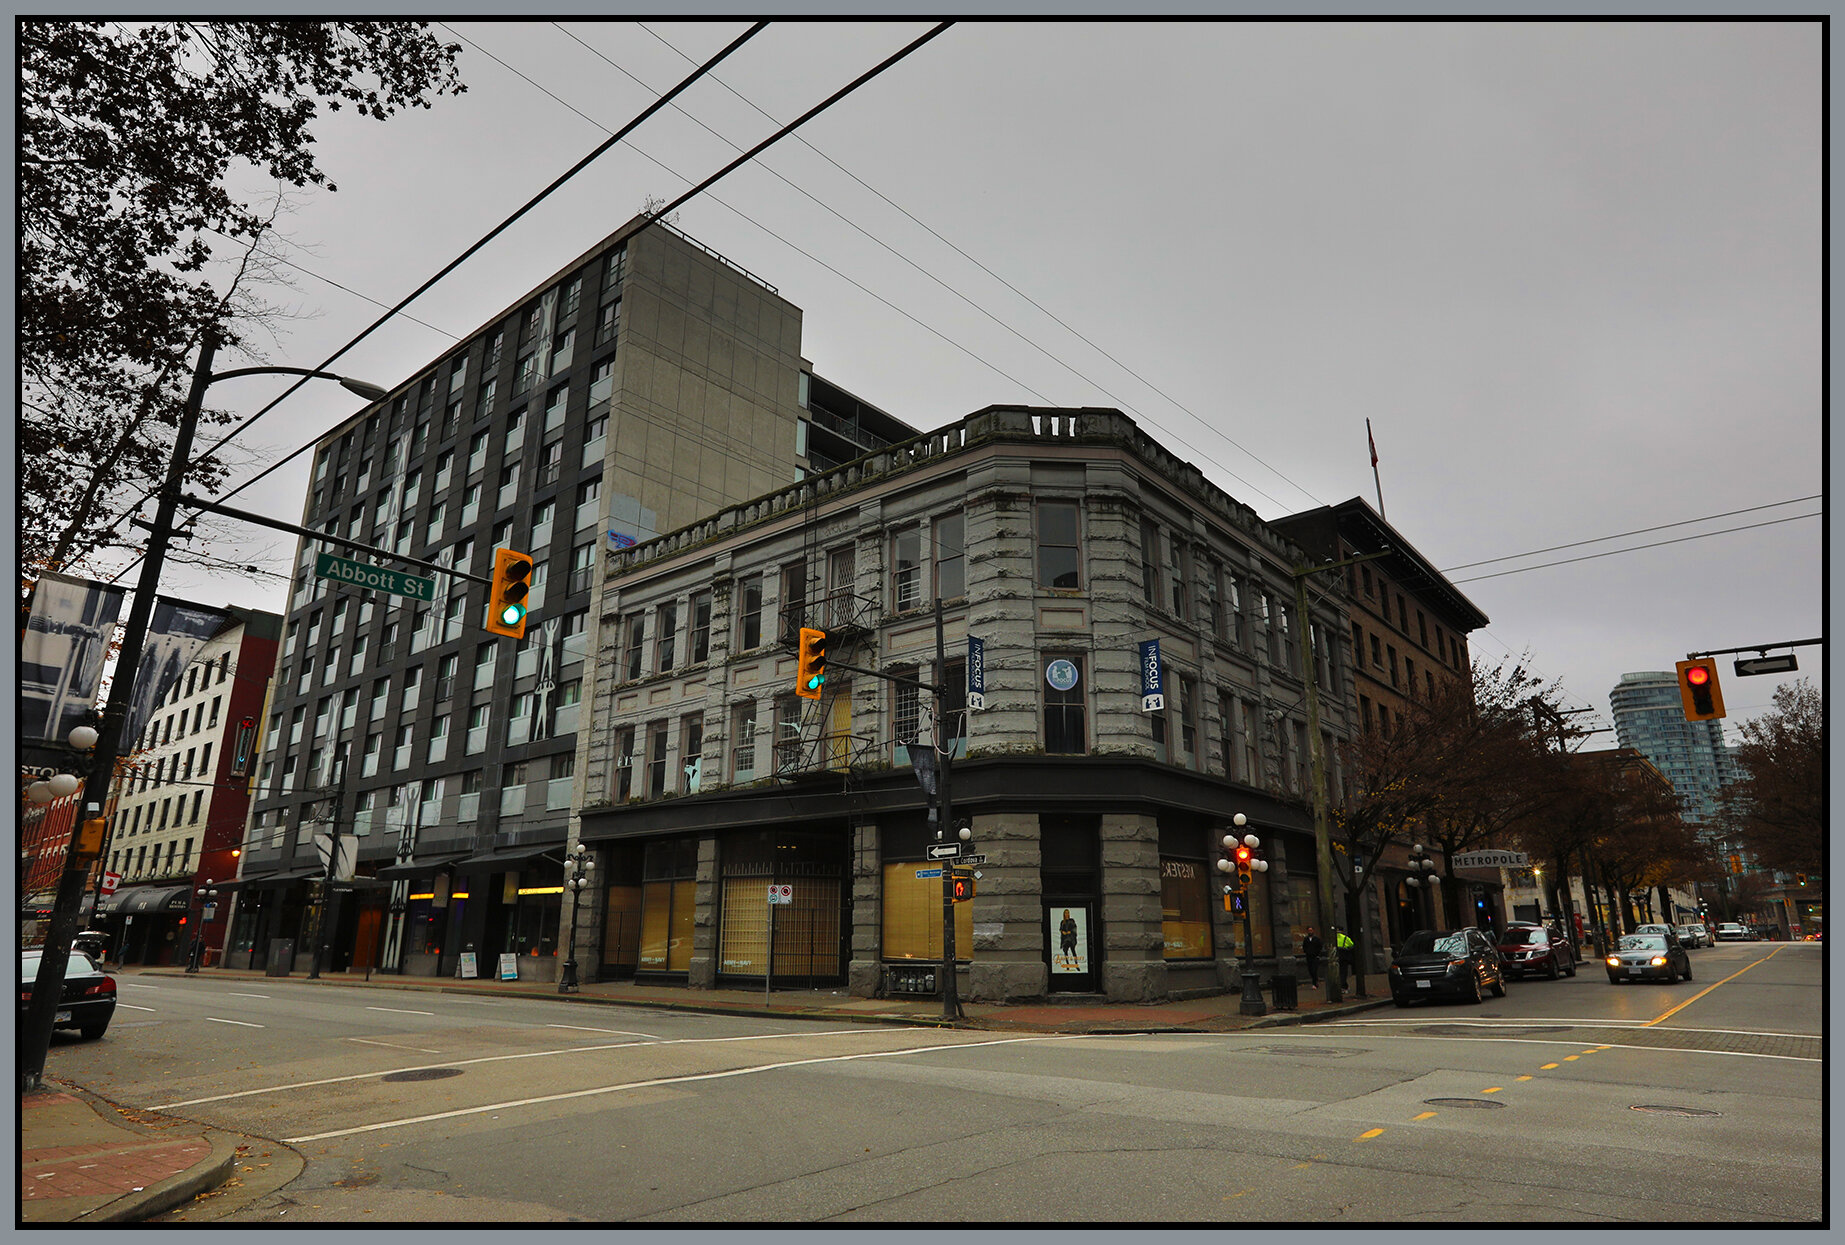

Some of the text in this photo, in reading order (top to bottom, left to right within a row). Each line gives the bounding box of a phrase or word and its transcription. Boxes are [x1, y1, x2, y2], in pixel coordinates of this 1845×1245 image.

[327, 561, 425, 596] Abbott St
[974, 643, 982, 689] INFOCUS
[1148, 645, 1159, 690] INFOCUS
[1454, 855, 1522, 866] METROPOLE
